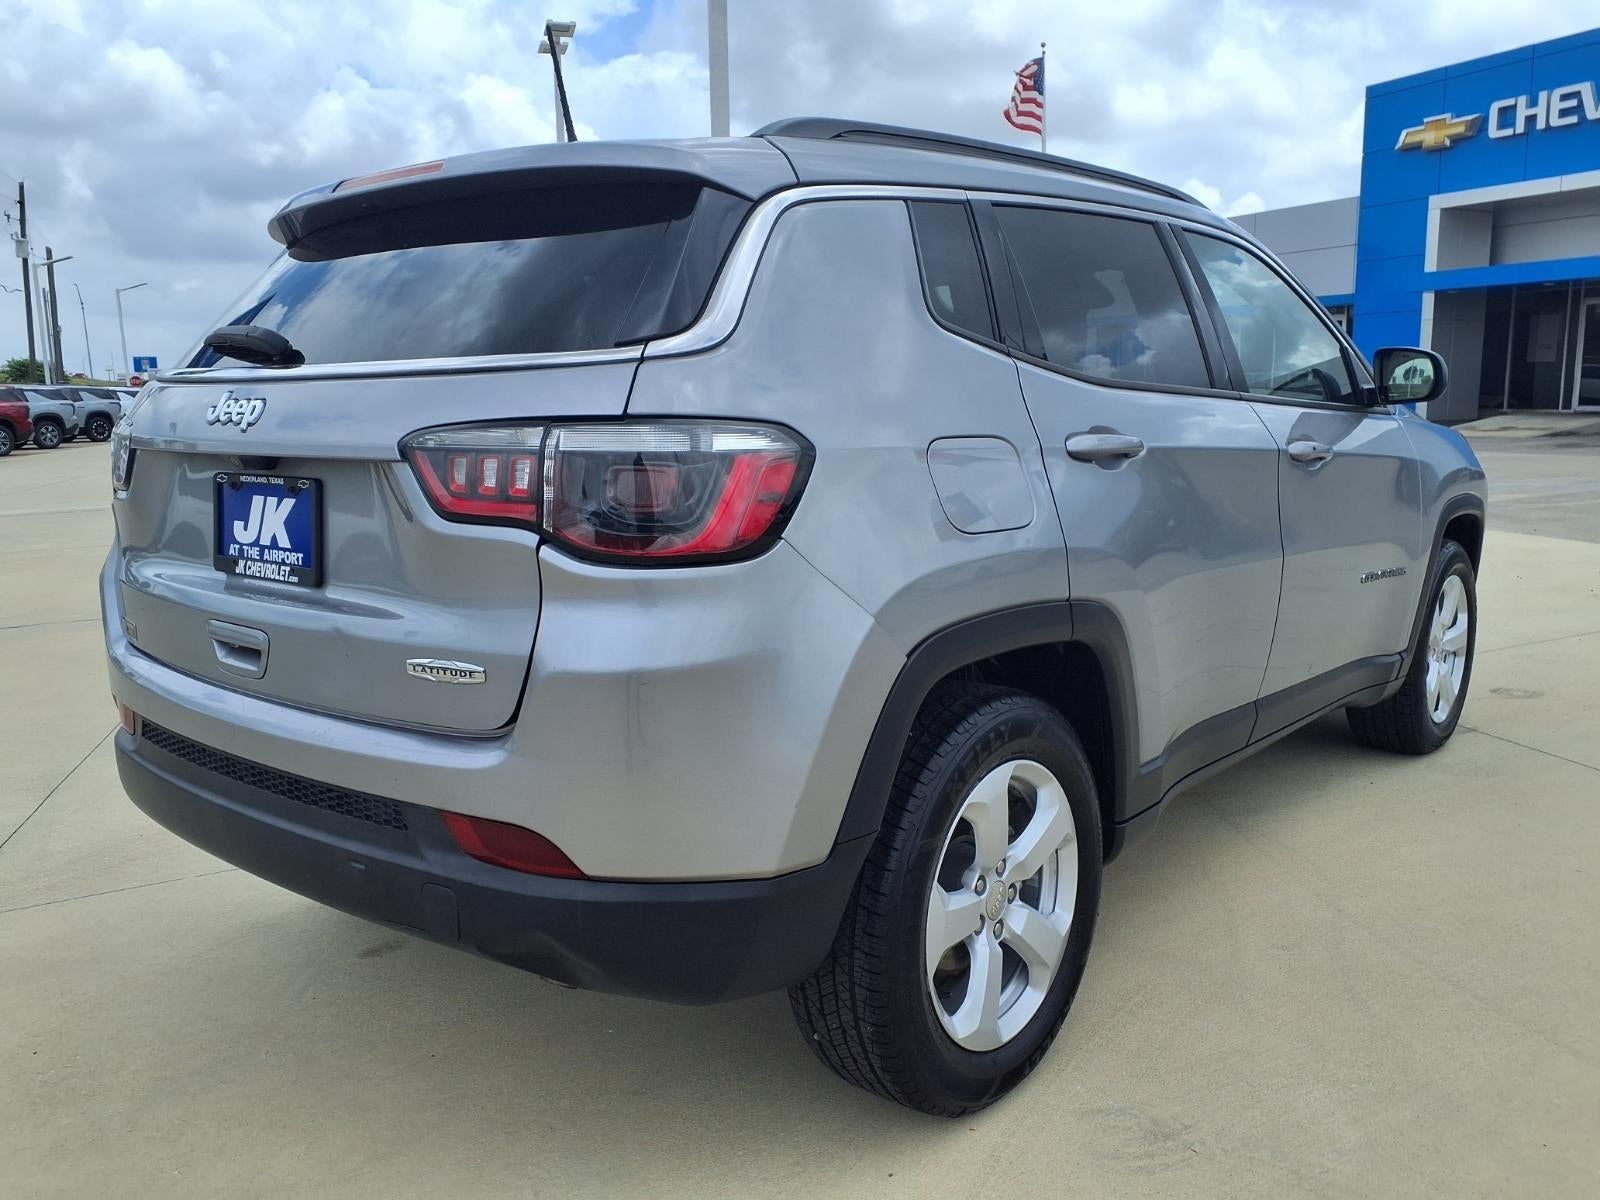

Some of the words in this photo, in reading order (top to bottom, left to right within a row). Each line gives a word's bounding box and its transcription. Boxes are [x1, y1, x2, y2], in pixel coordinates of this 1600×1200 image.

[206, 391, 266, 433] Jeep
[268, 477, 285, 485] TEXAS
[233, 495, 296, 549] JK
[229, 543, 240, 556] AT
[242, 546, 260, 559] THE
[263, 548, 304, 566] AIRPORT
[235, 560, 246, 574] JK
[412, 664, 477, 678] LATITUDE
